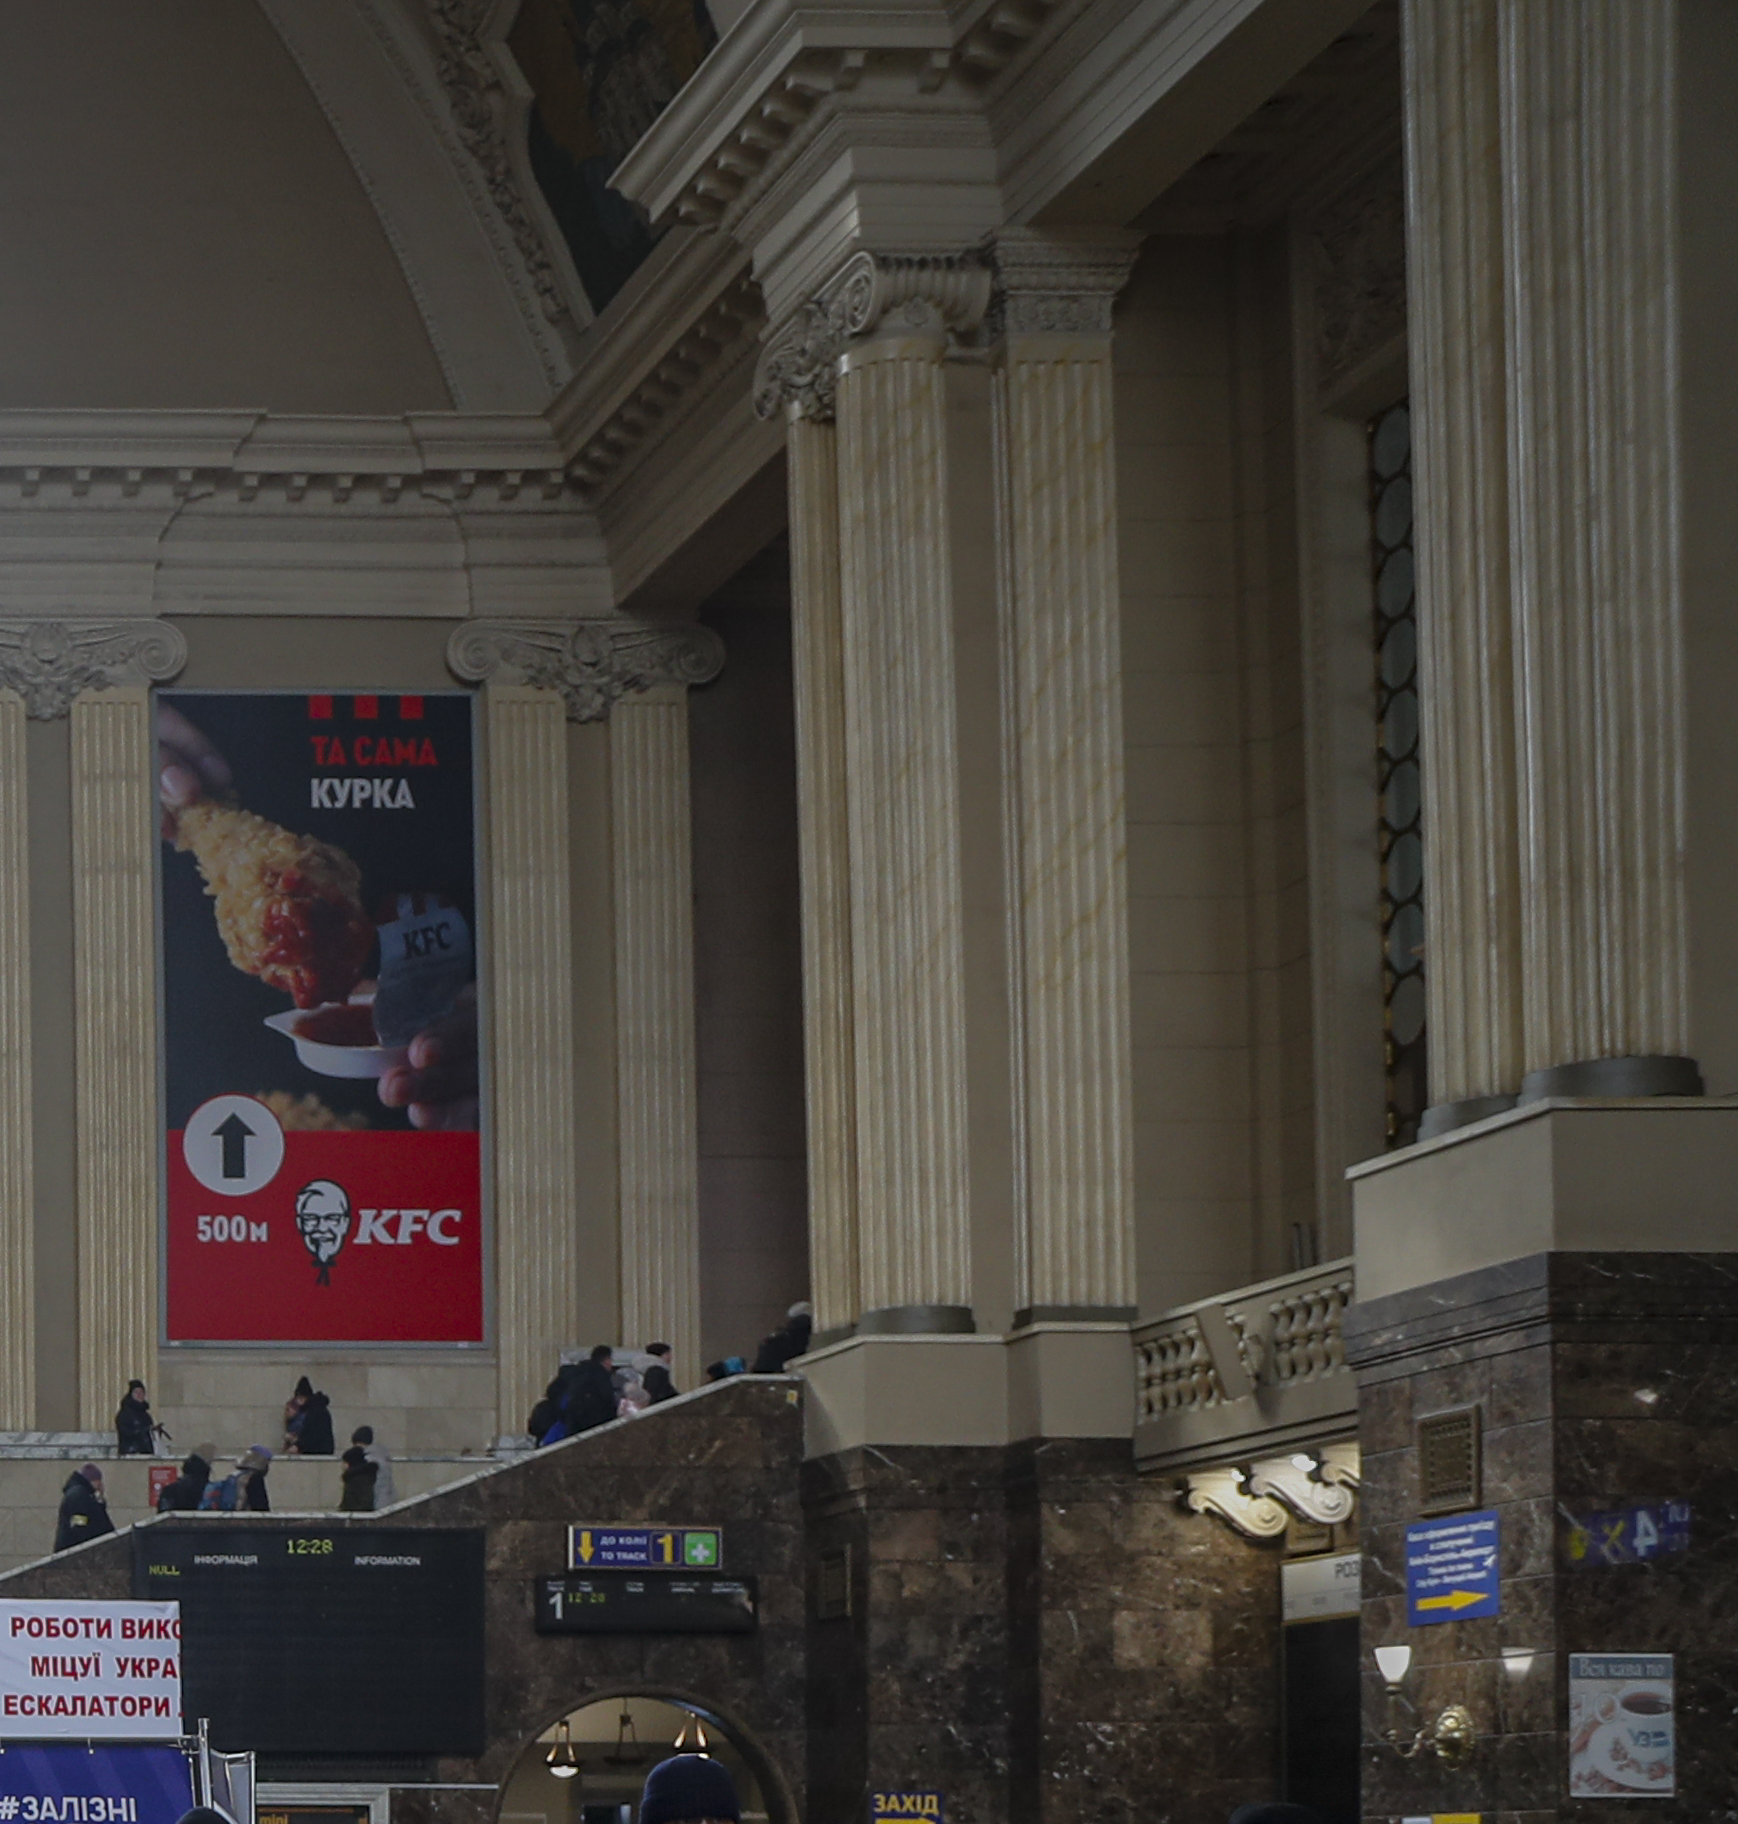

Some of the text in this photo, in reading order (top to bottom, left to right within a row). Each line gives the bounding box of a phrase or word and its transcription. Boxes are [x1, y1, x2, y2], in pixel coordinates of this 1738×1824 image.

[311, 735, 438, 767] ТА САМА
[311, 779, 414, 809] КУРКА
[402, 921, 451, 959] KFC
[353, 1209, 461, 1245] KFC
[287, 1539, 333, 1554] 12:28
[600, 1536, 616, 1546] ДО
[657, 1533, 674, 1564] 1
[194, 1555, 258, 1566] ІНФОРМАЦІЯ
[354, 1555, 421, 1566] INFORMATION
[616, 1551, 647, 1561] TRACK
[149, 1565, 180, 1576] NULL
[548, 1592, 564, 1620] 1
[10, 1617, 112, 1640] РОБОТИ
[30, 1652, 181, 1681] МІЦУЇ УКРА
[3, 1695, 171, 1718] ЕСКАЛАТОРИ
[873, 1793, 940, 1816] ЗАХІД
